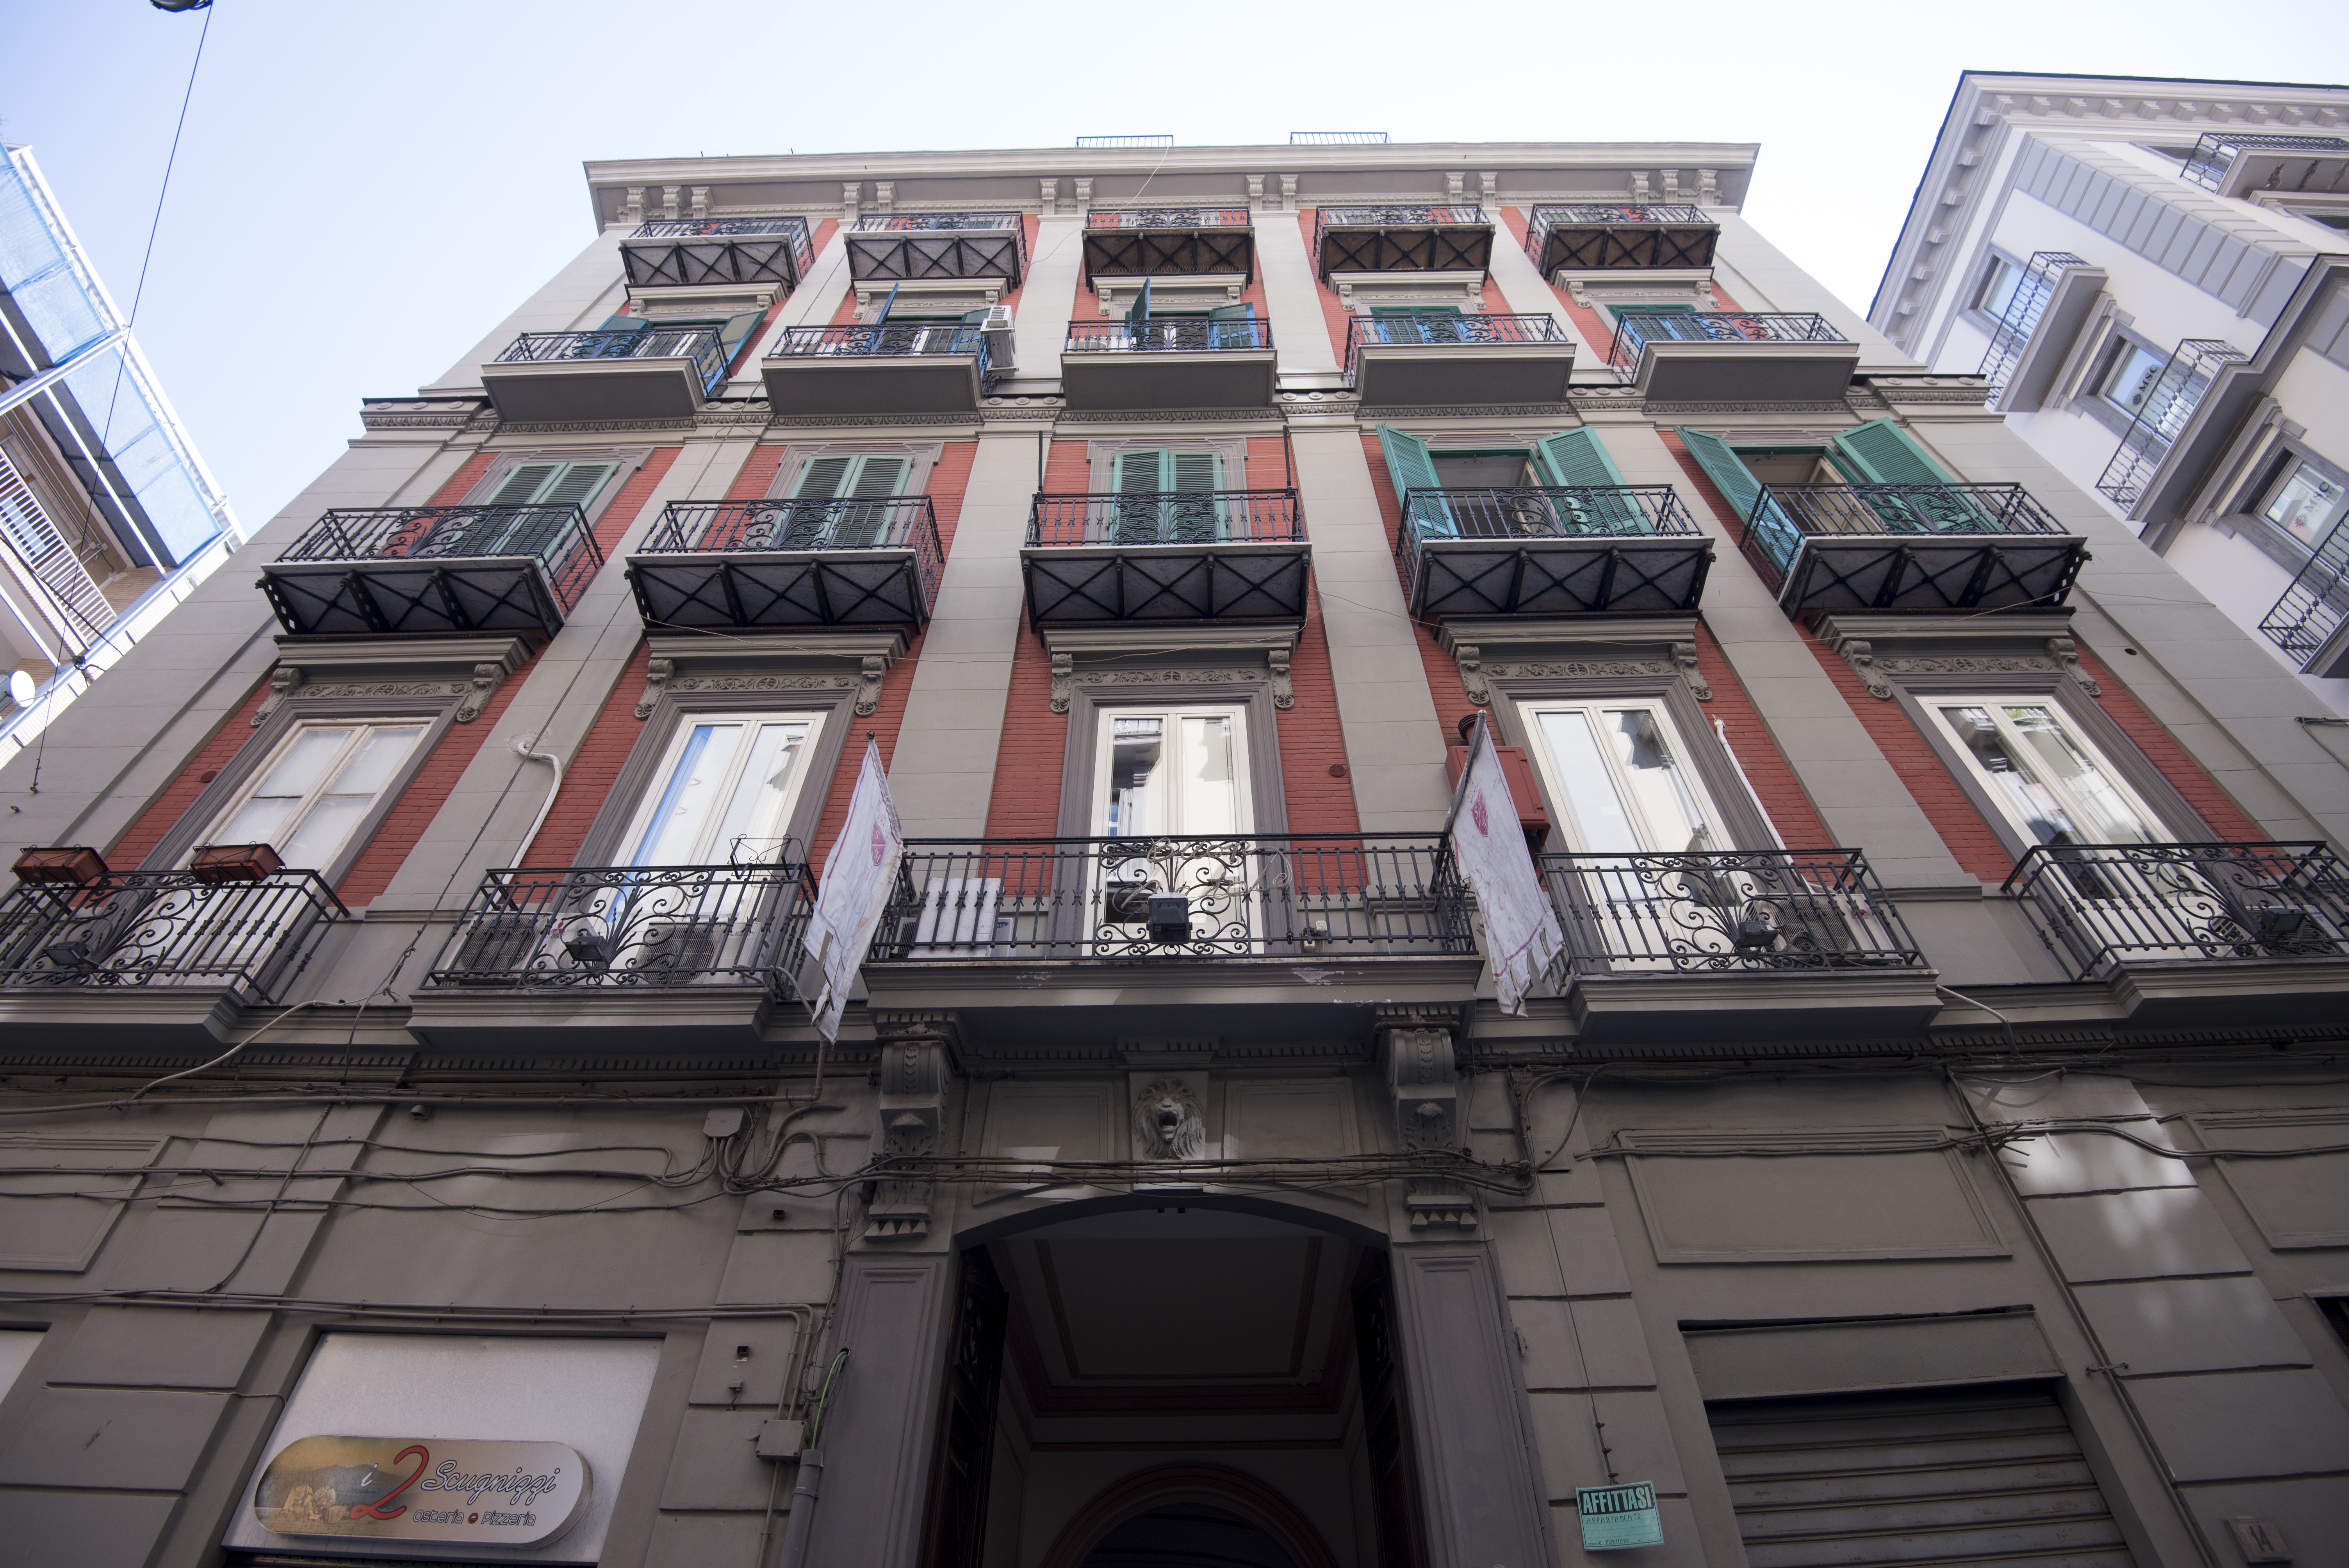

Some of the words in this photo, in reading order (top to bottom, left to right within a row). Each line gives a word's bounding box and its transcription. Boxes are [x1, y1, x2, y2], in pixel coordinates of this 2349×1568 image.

[2139, 364, 2158, 392] MSC
[2303, 482, 2329, 513] MSC
[350, 1445, 430, 1520] 2
[361, 1463, 379, 1487] i
[421, 1459, 561, 1506] Scugnizzi
[1583, 1486, 1652, 1513] AFFITTASI
[413, 1509, 464, 1524] Osteria
[468, 1513, 479, 1524] e
[481, 1511, 536, 1526] Pizzeria
[1587, 1513, 1641, 1524] APPARTAMENTO
[2249, 1525, 2274, 1552] 14
